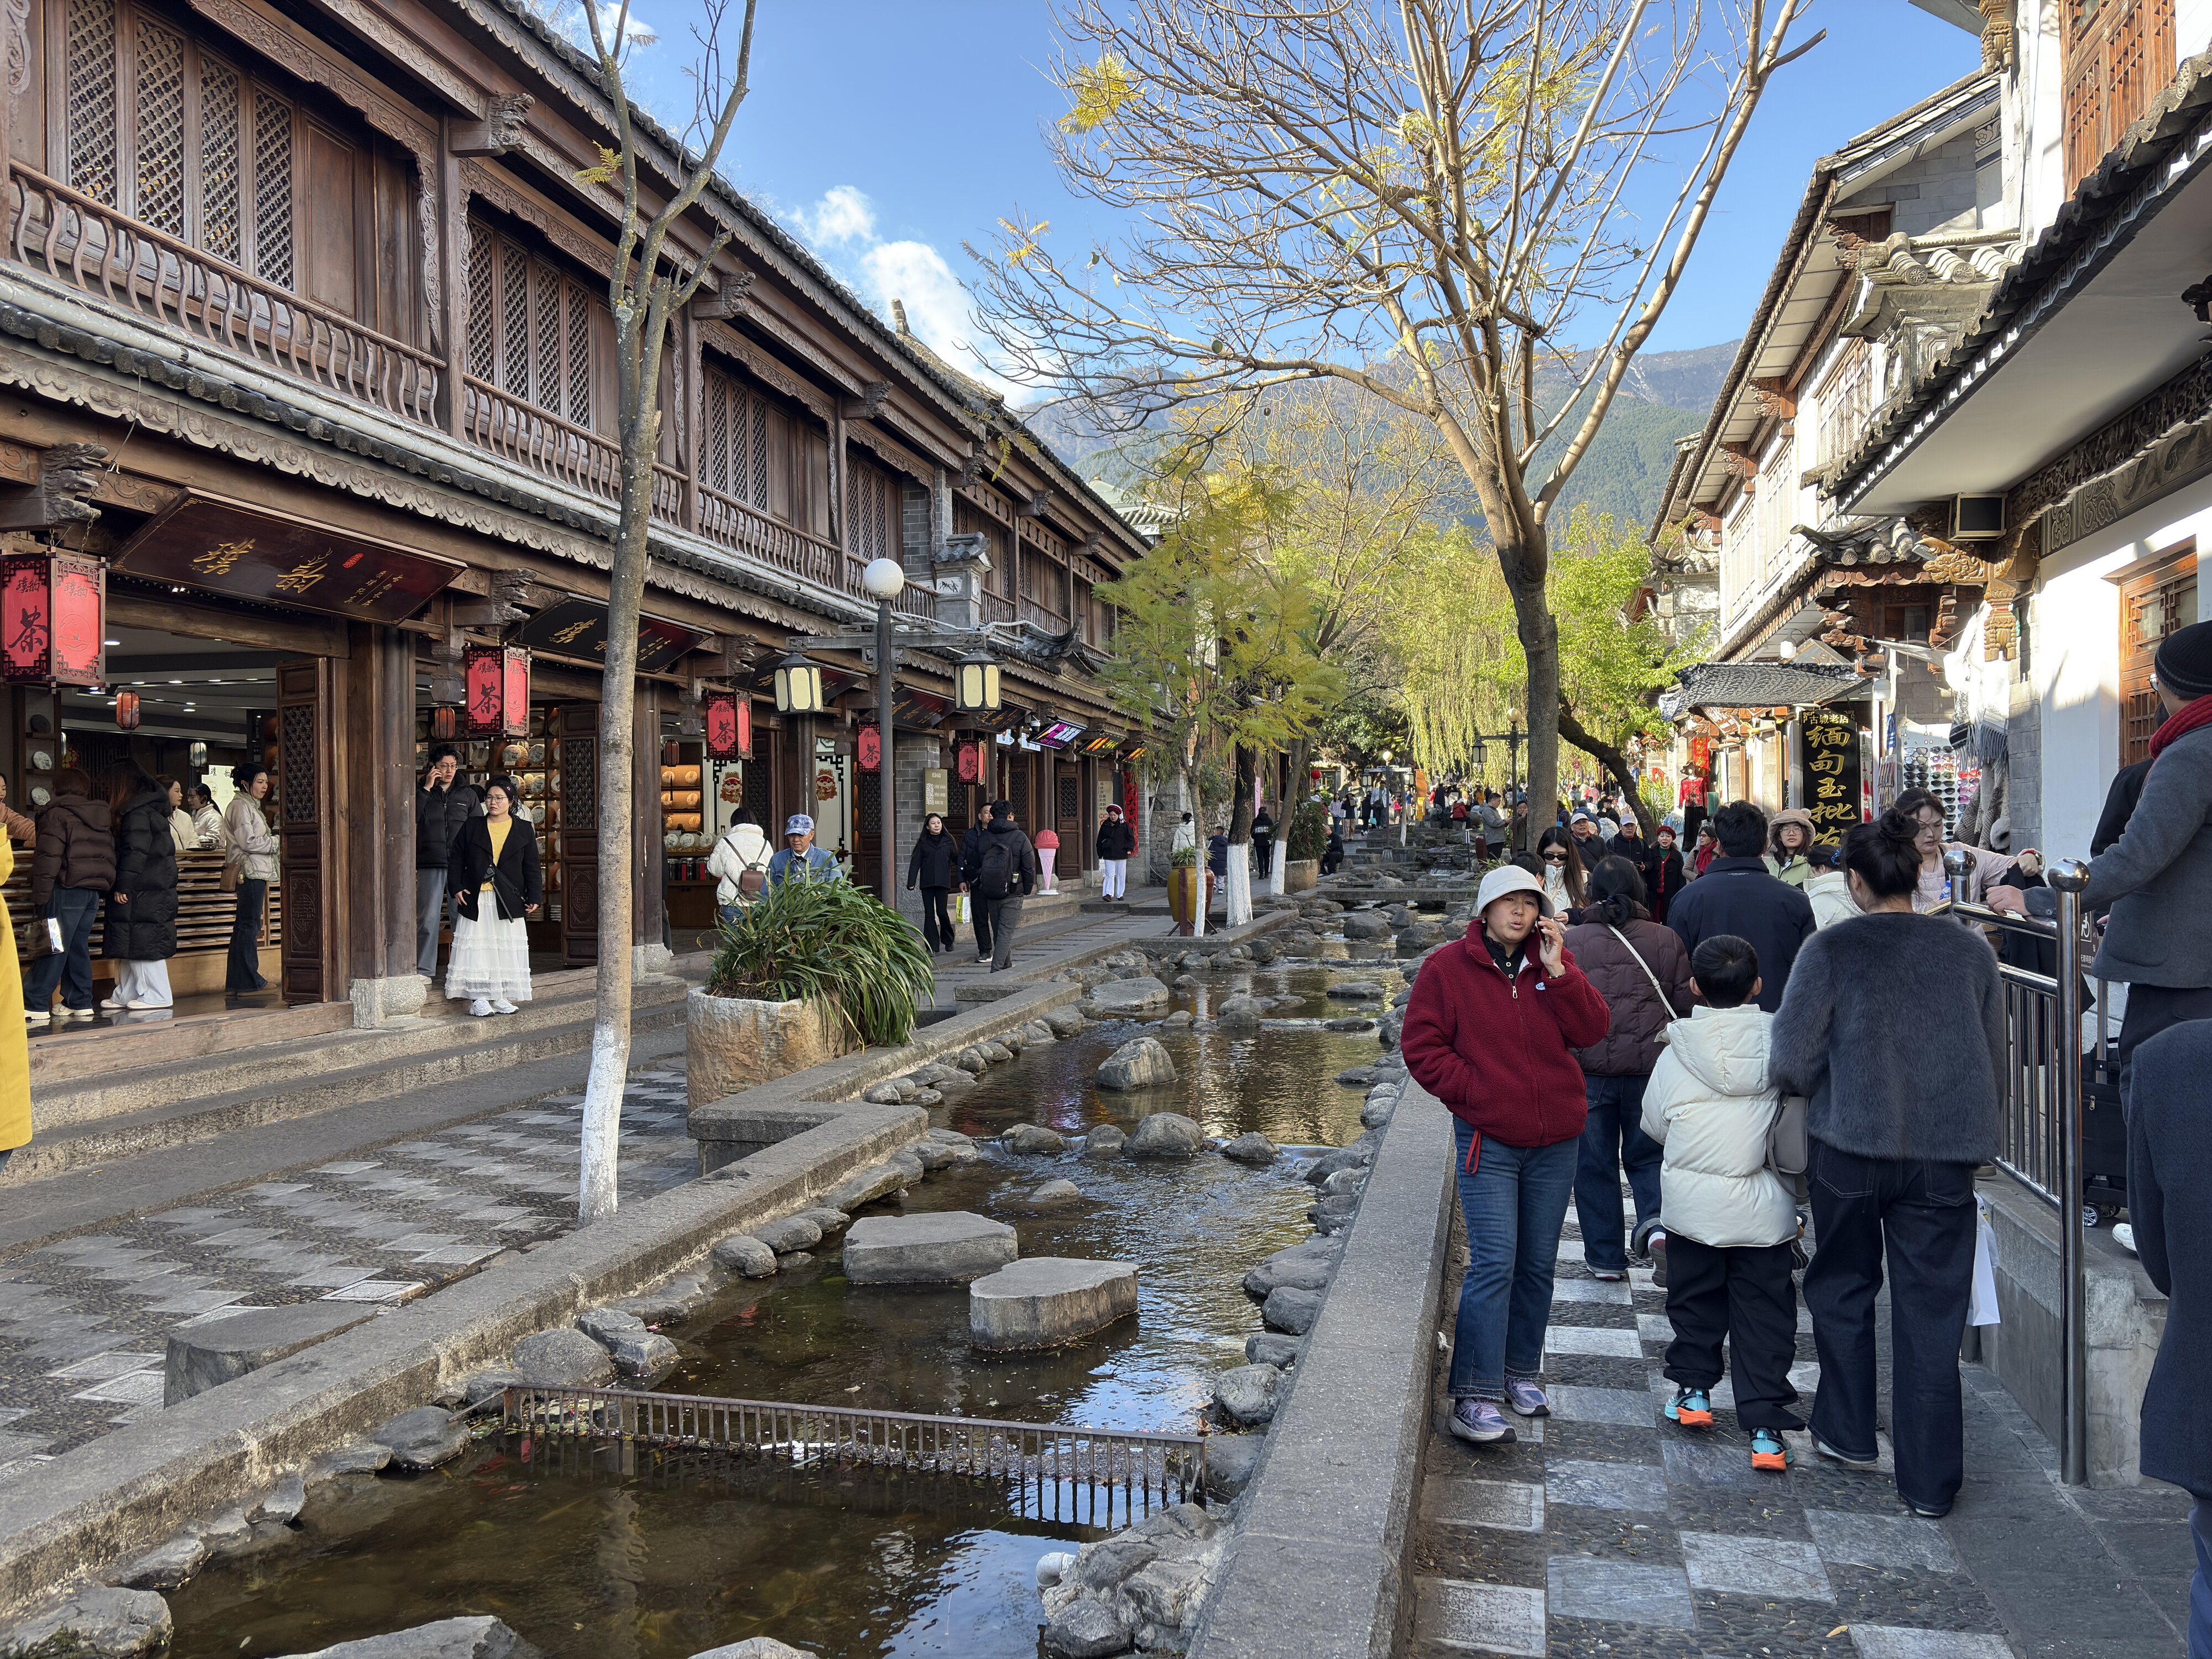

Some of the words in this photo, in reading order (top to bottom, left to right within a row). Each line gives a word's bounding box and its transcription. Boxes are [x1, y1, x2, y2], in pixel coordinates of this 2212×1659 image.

[16, 576, 40, 593] 璞韵
[64, 580, 88, 598] 璞韵
[7, 605, 48, 653] 茶
[478, 660, 495, 674] 璞韵
[471, 681, 500, 714] 茶
[1809, 714, 1849, 724] 古城老店
[710, 719, 735, 744] 茶
[860, 743, 880, 763] 茶
[960, 758, 977, 774] 茶
